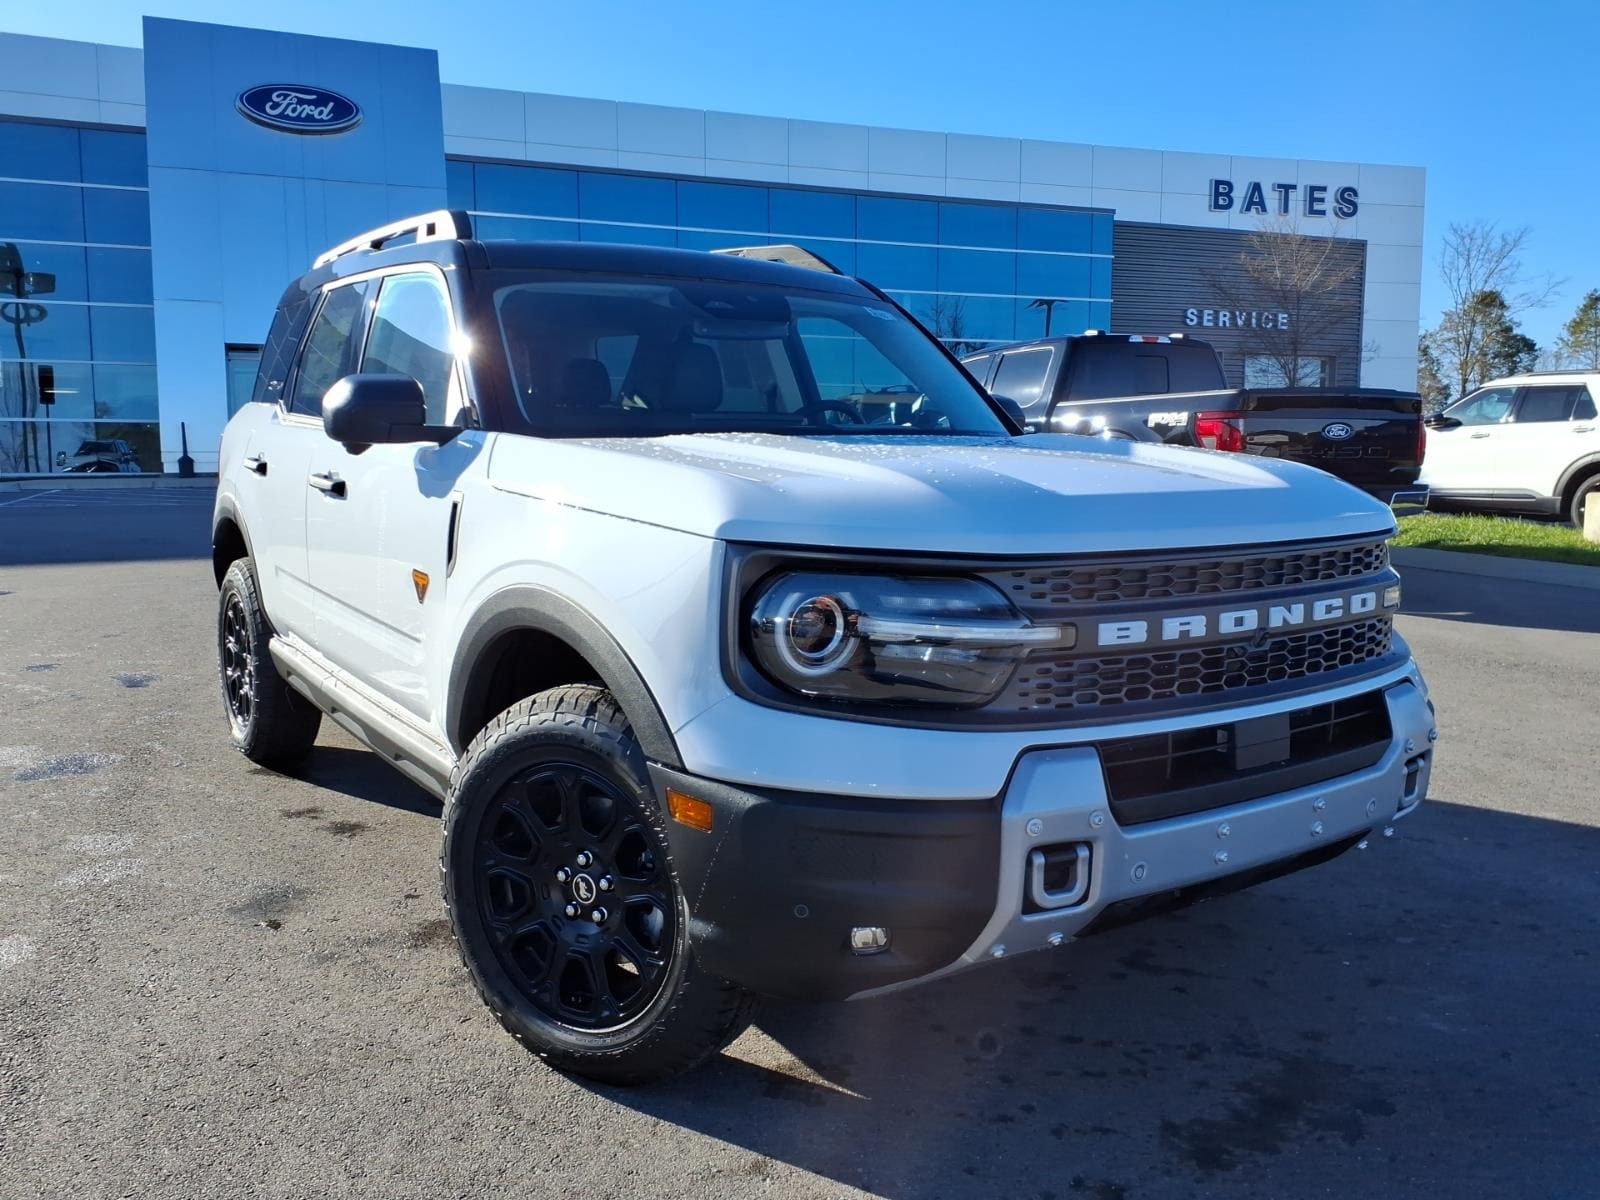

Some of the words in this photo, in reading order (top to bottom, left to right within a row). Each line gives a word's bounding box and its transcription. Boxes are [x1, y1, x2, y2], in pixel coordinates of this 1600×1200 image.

[265, 90, 334, 120] Ford
[1209, 178, 1359, 219] BATES
[1185, 308, 1289, 330] SERVICE
[1097, 591, 1377, 646] BRONCO
